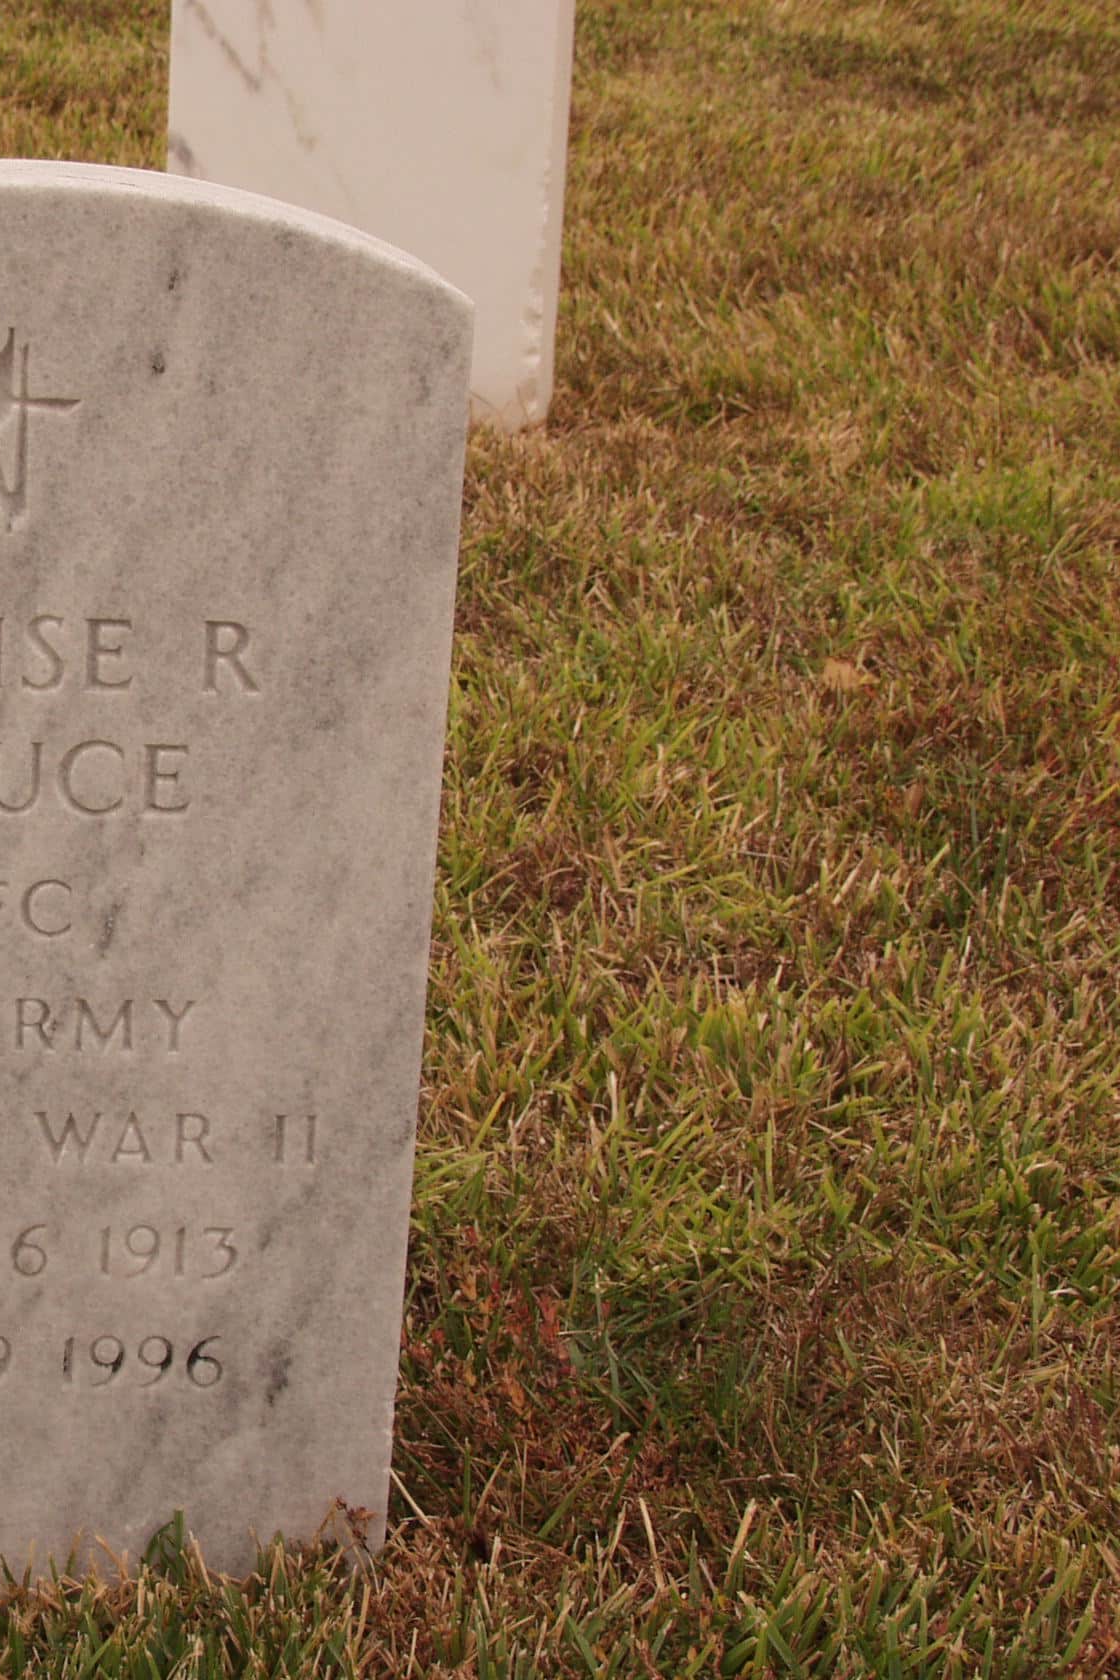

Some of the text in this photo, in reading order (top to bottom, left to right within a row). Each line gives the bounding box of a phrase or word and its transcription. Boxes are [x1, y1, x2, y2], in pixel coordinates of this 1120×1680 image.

[203, 620, 260, 694] R
[34, 1110, 214, 1164] WAR
[272, 1113, 317, 1164] II
[99, 1225, 239, 1279] 1913
[62, 1334, 223, 1388] 1996
